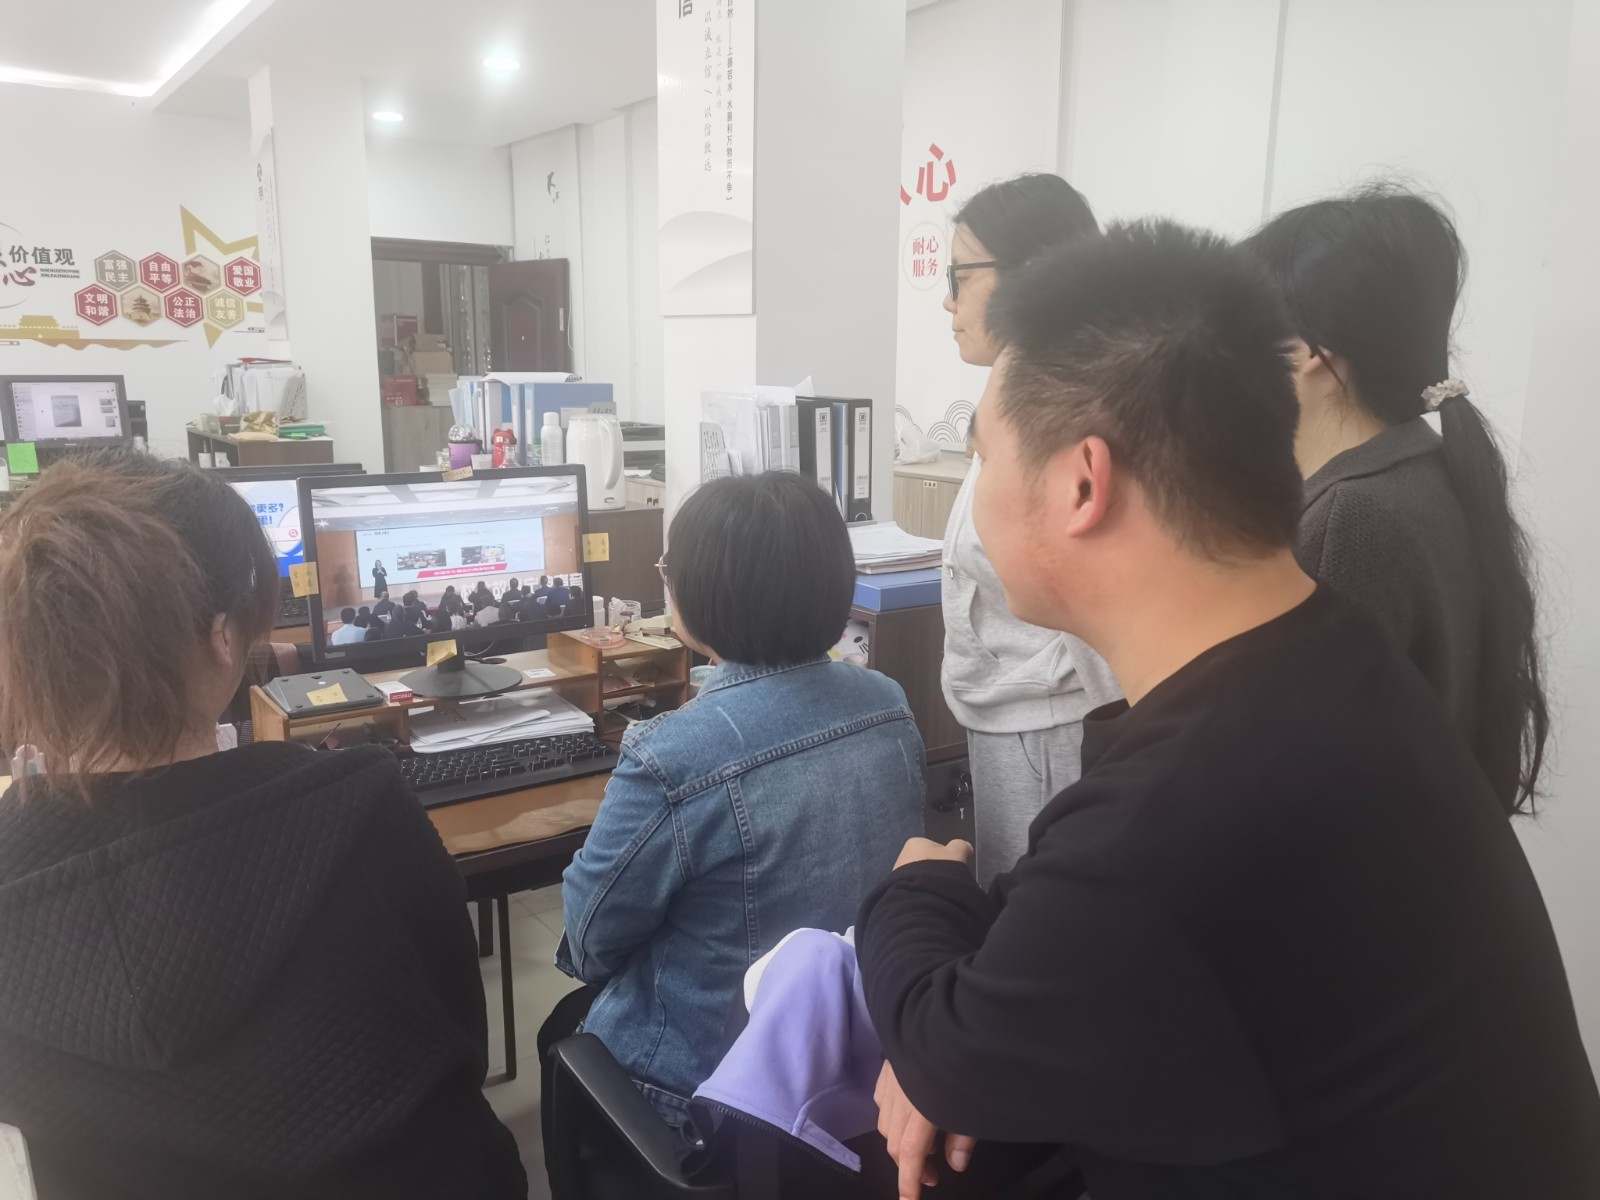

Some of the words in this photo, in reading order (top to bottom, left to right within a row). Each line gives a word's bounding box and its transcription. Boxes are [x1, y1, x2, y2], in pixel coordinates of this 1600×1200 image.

[900, 143, 957, 206] 心
[912, 236, 939, 256] 耐心
[9, 245, 75, 266] 价值观
[103, 259, 128, 271] 富强
[149, 261, 171, 272] 自由
[232, 265, 254, 276] 爱国
[912, 258, 939, 278] 服务
[105, 271, 130, 283] 民主
[149, 273, 173, 285] 平等
[233, 277, 255, 288] 敬业
[84, 292, 109, 304] 文明
[173, 296, 196, 307] 公正
[214, 298, 236, 308] 诚信
[85, 305, 109, 317] 和谐
[173, 308, 196, 319] 法治
[215, 309, 237, 320] 友善
